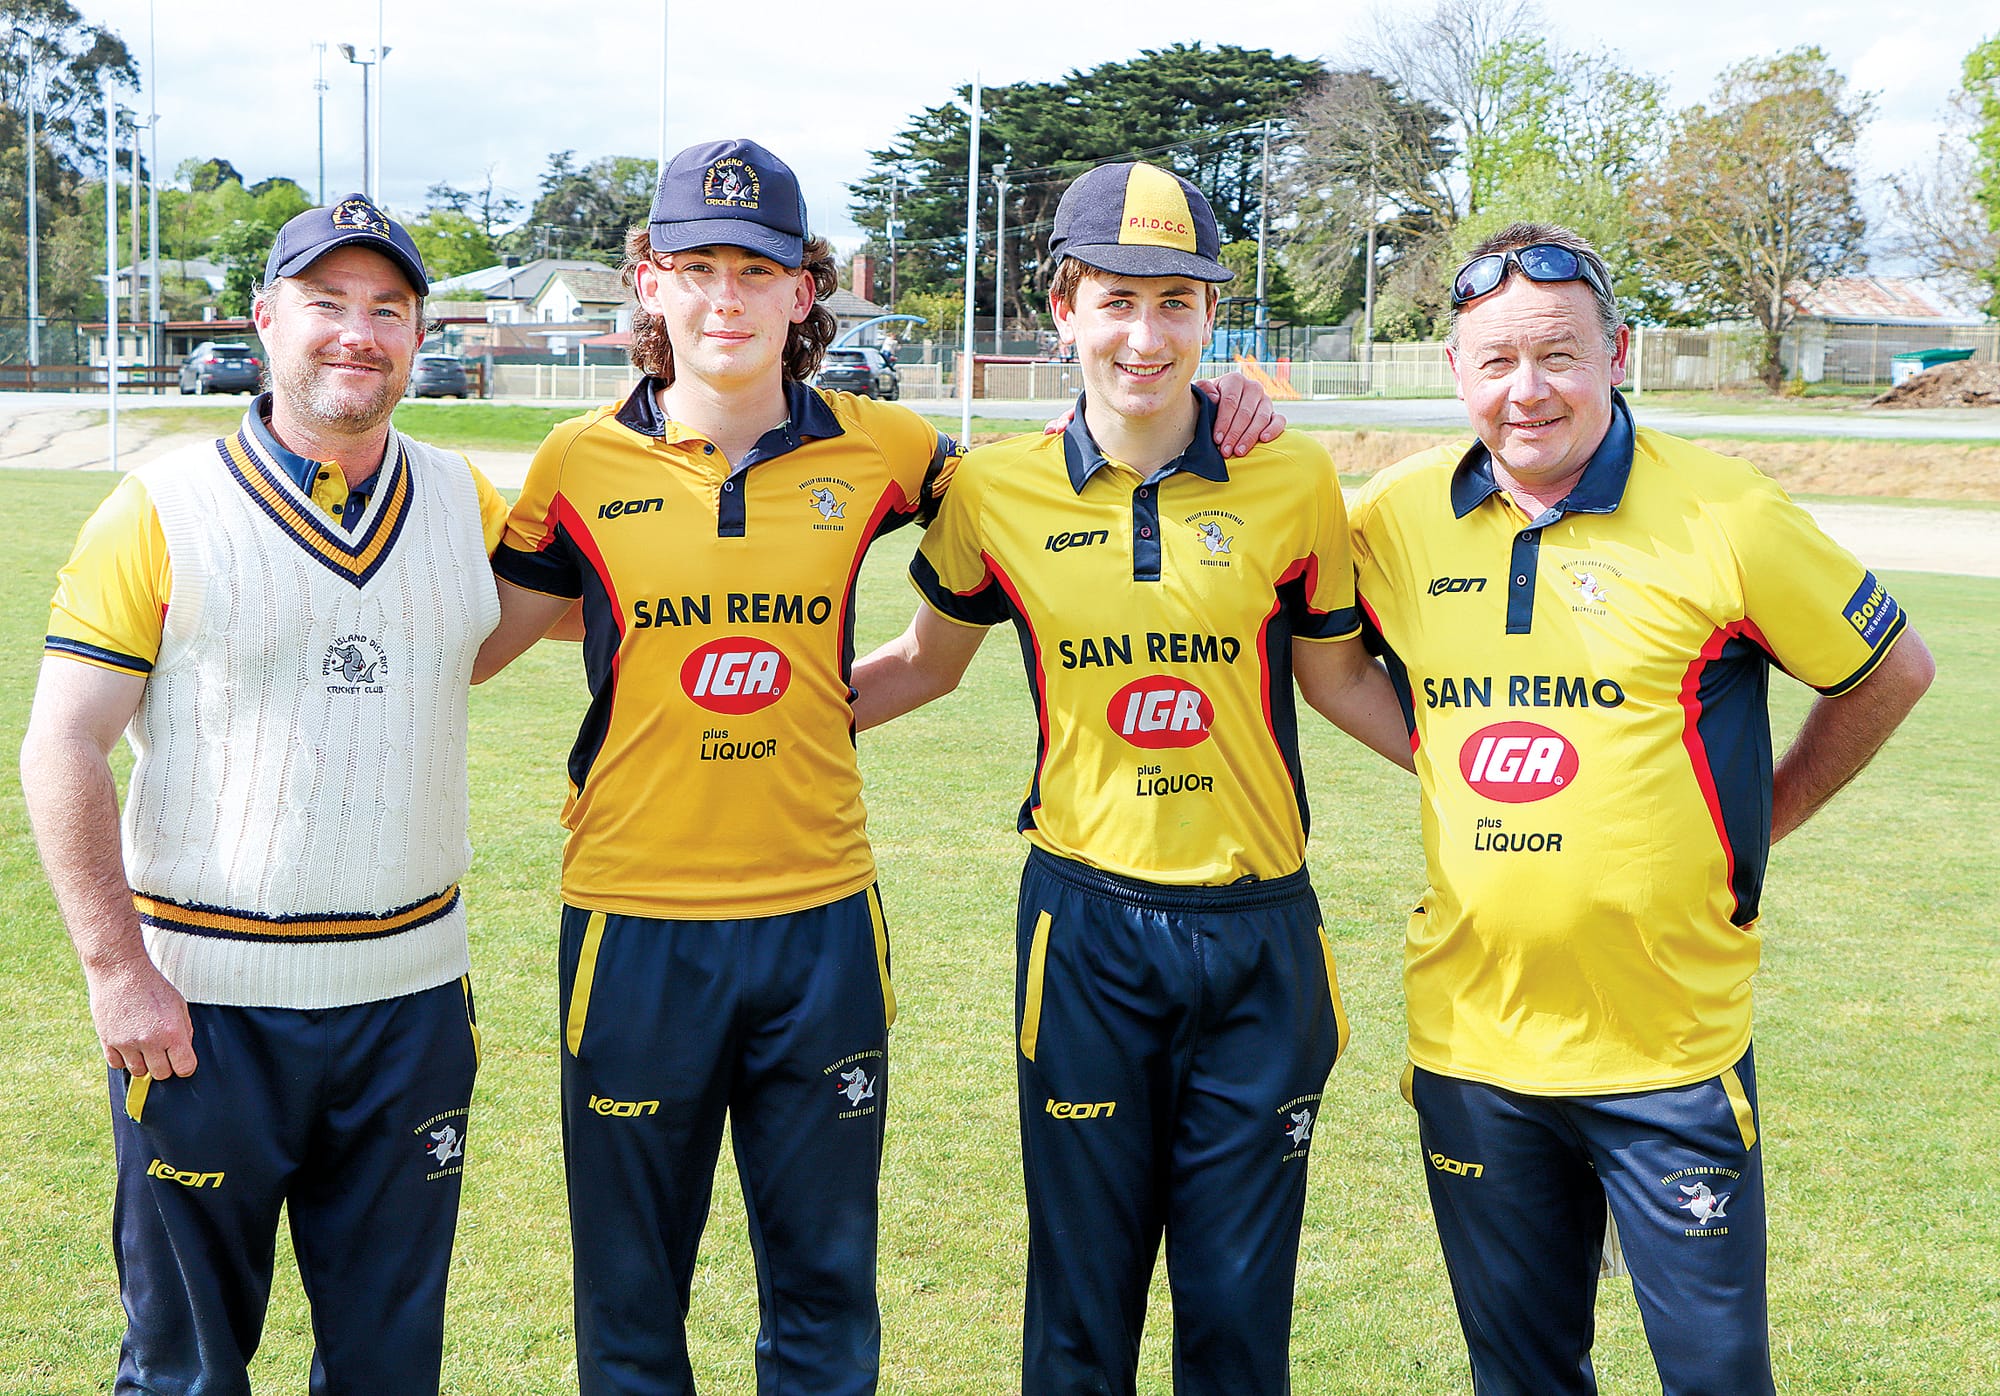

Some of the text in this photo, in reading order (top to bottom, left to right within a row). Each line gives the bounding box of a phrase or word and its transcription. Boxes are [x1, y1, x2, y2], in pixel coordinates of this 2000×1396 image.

[740, 201, 759, 209] CLUB
[1129, 217, 1188, 235] P.I.D.C.C.
[634, 593, 831, 628] SAN REMO
[1863, 624, 1876, 638] THE
[323, 634, 388, 676] PHILLIP ISLAND DISTRICT
[1059, 632, 1241, 669] SAN REMO
[693, 651, 780, 697] IGA
[327, 686, 384, 694] CRICKET CLUB
[1424, 676, 1625, 708] SAN REMO
[1122, 690, 1202, 735] IGA
[702, 728, 729, 741] plus
[700, 739, 777, 760] LIQUOR
[1469, 737, 1565, 783] IGA
[1137, 764, 1161, 777] plus
[1136, 774, 1213, 796] LIQUOR
[1477, 817, 1502, 830] plus
[1474, 833, 1563, 852] LIQUOR
[839, 1109, 862, 1119] CRICKET
[1660, 1170, 1683, 1186] PHILLIP
[1684, 1166, 1708, 1176] ISLAND
[1685, 1226, 1729, 1237] CRICKET CLUB
